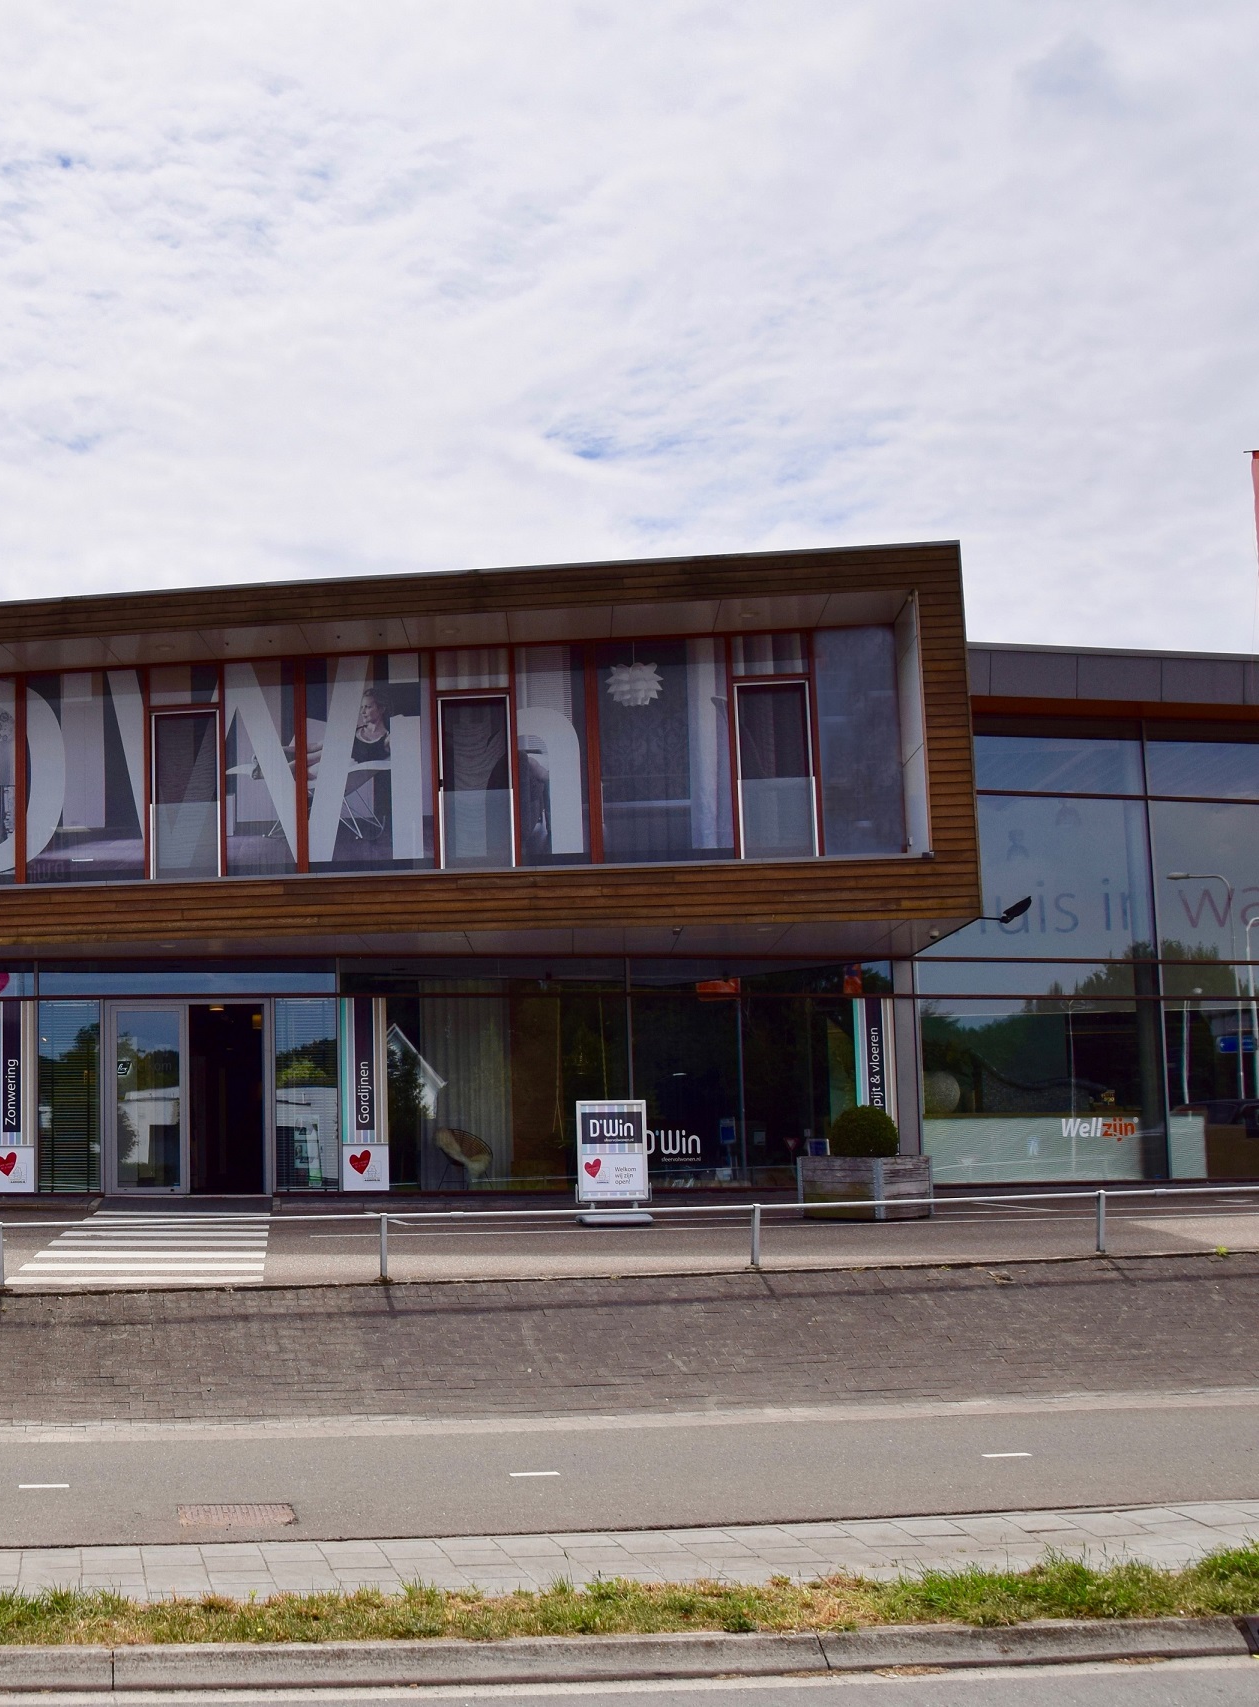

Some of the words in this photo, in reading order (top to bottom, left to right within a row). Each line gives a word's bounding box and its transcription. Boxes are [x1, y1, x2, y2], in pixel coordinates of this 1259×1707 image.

[869, 1027, 880, 1073] vloeren
[870, 1075, 881, 1084] &
[5, 1059, 19, 1126] Zonwering
[358, 1061, 372, 1124] Gordijnen
[871, 1087, 884, 1110] pijt
[589, 1119, 634, 1138] D'Win
[1061, 1116, 1136, 1142] Wellzijn
[645, 1130, 701, 1155] D'Win
